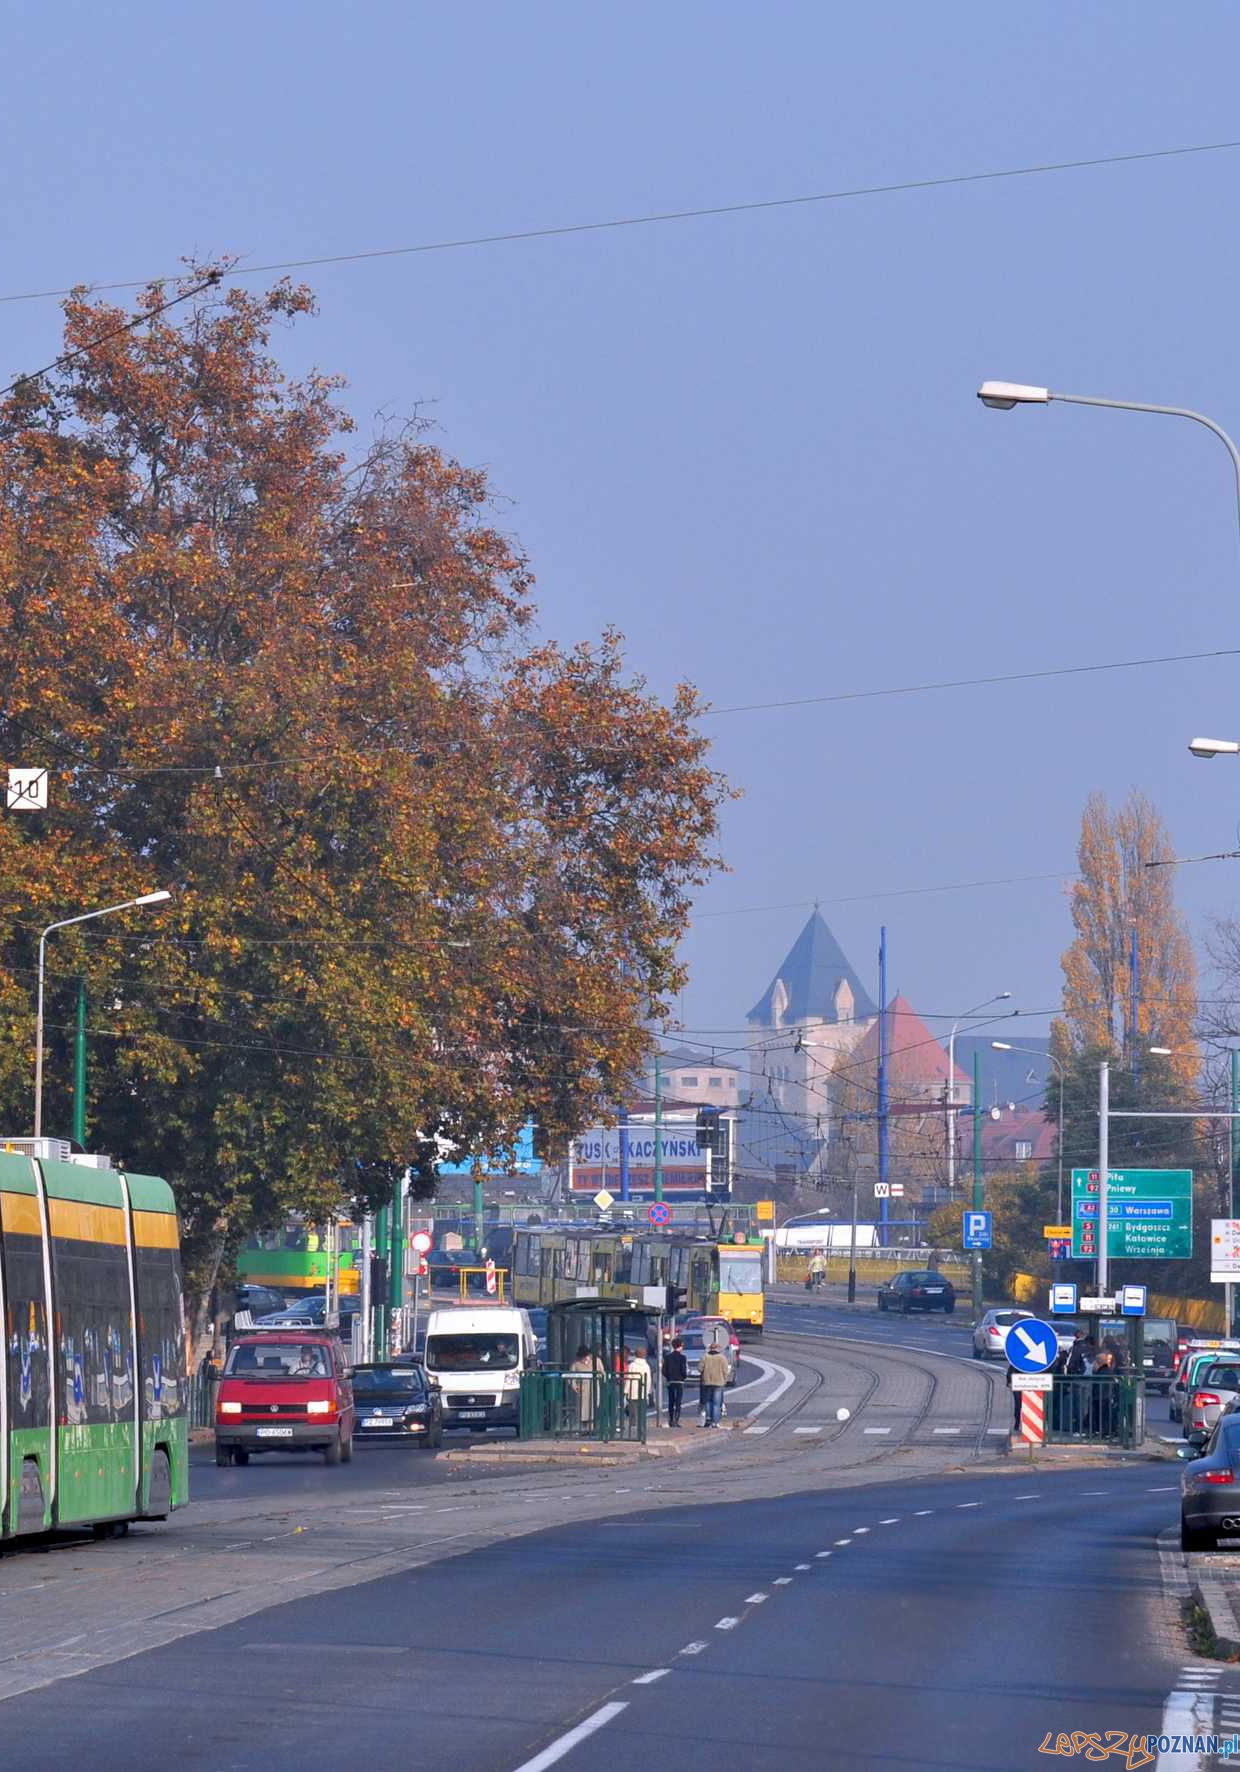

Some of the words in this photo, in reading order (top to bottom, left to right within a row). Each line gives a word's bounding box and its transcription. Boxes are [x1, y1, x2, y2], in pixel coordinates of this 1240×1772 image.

[14, 780, 39, 799] 10
[876, 1185, 888, 1195] W
[1125, 1206, 1170, 1215] Warszawa
[1125, 1234, 1167, 1243] Katowice
